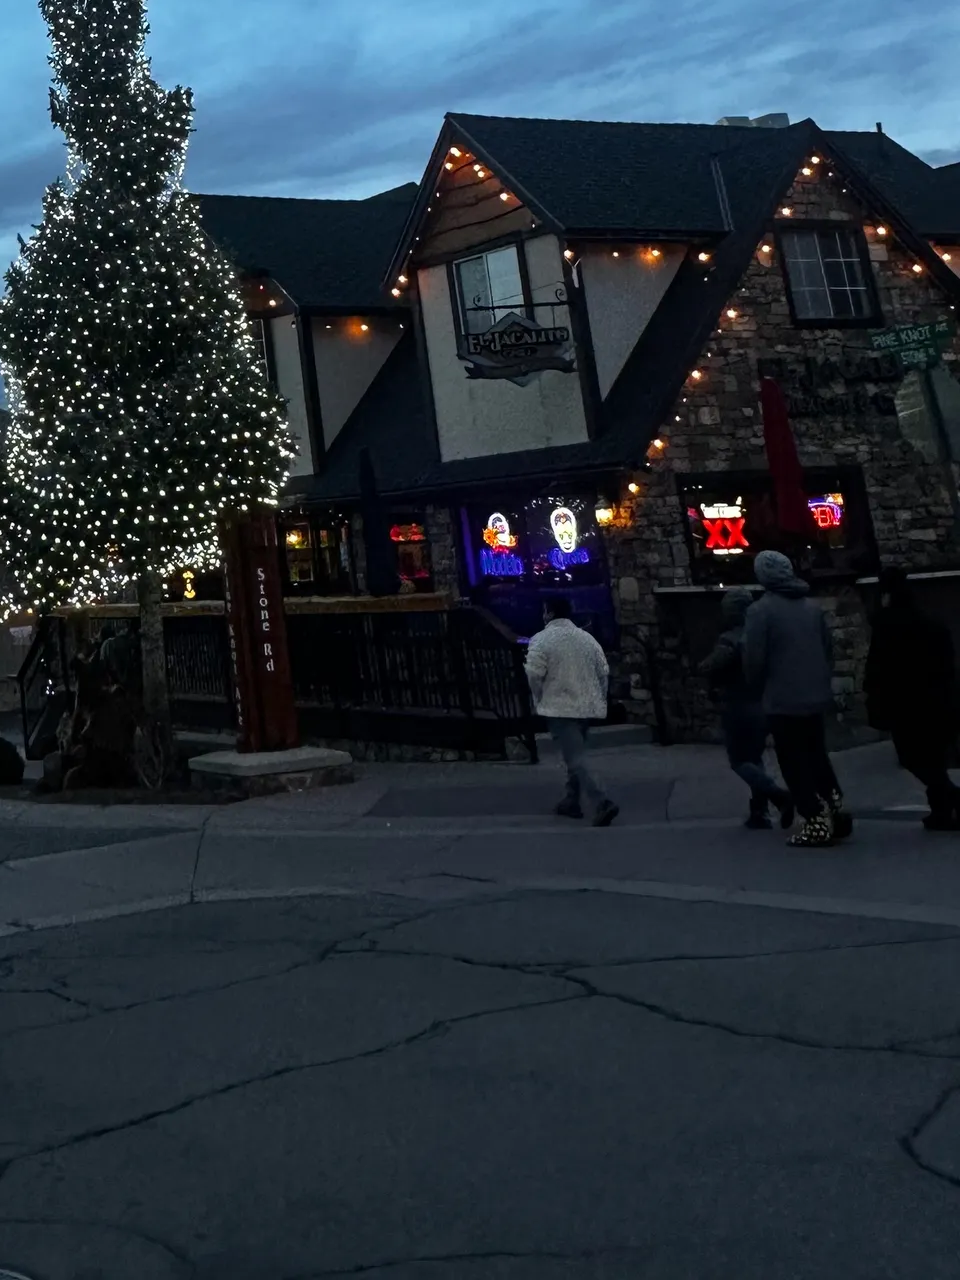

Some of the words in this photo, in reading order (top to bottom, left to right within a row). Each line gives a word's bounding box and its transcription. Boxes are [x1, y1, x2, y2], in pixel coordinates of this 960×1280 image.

[871, 332, 899, 349] PINE
[900, 325, 931, 344] KNOT
[702, 518, 750, 548] XX
[256, 567, 271, 632] Stone
[263, 642, 275, 672] Rd
